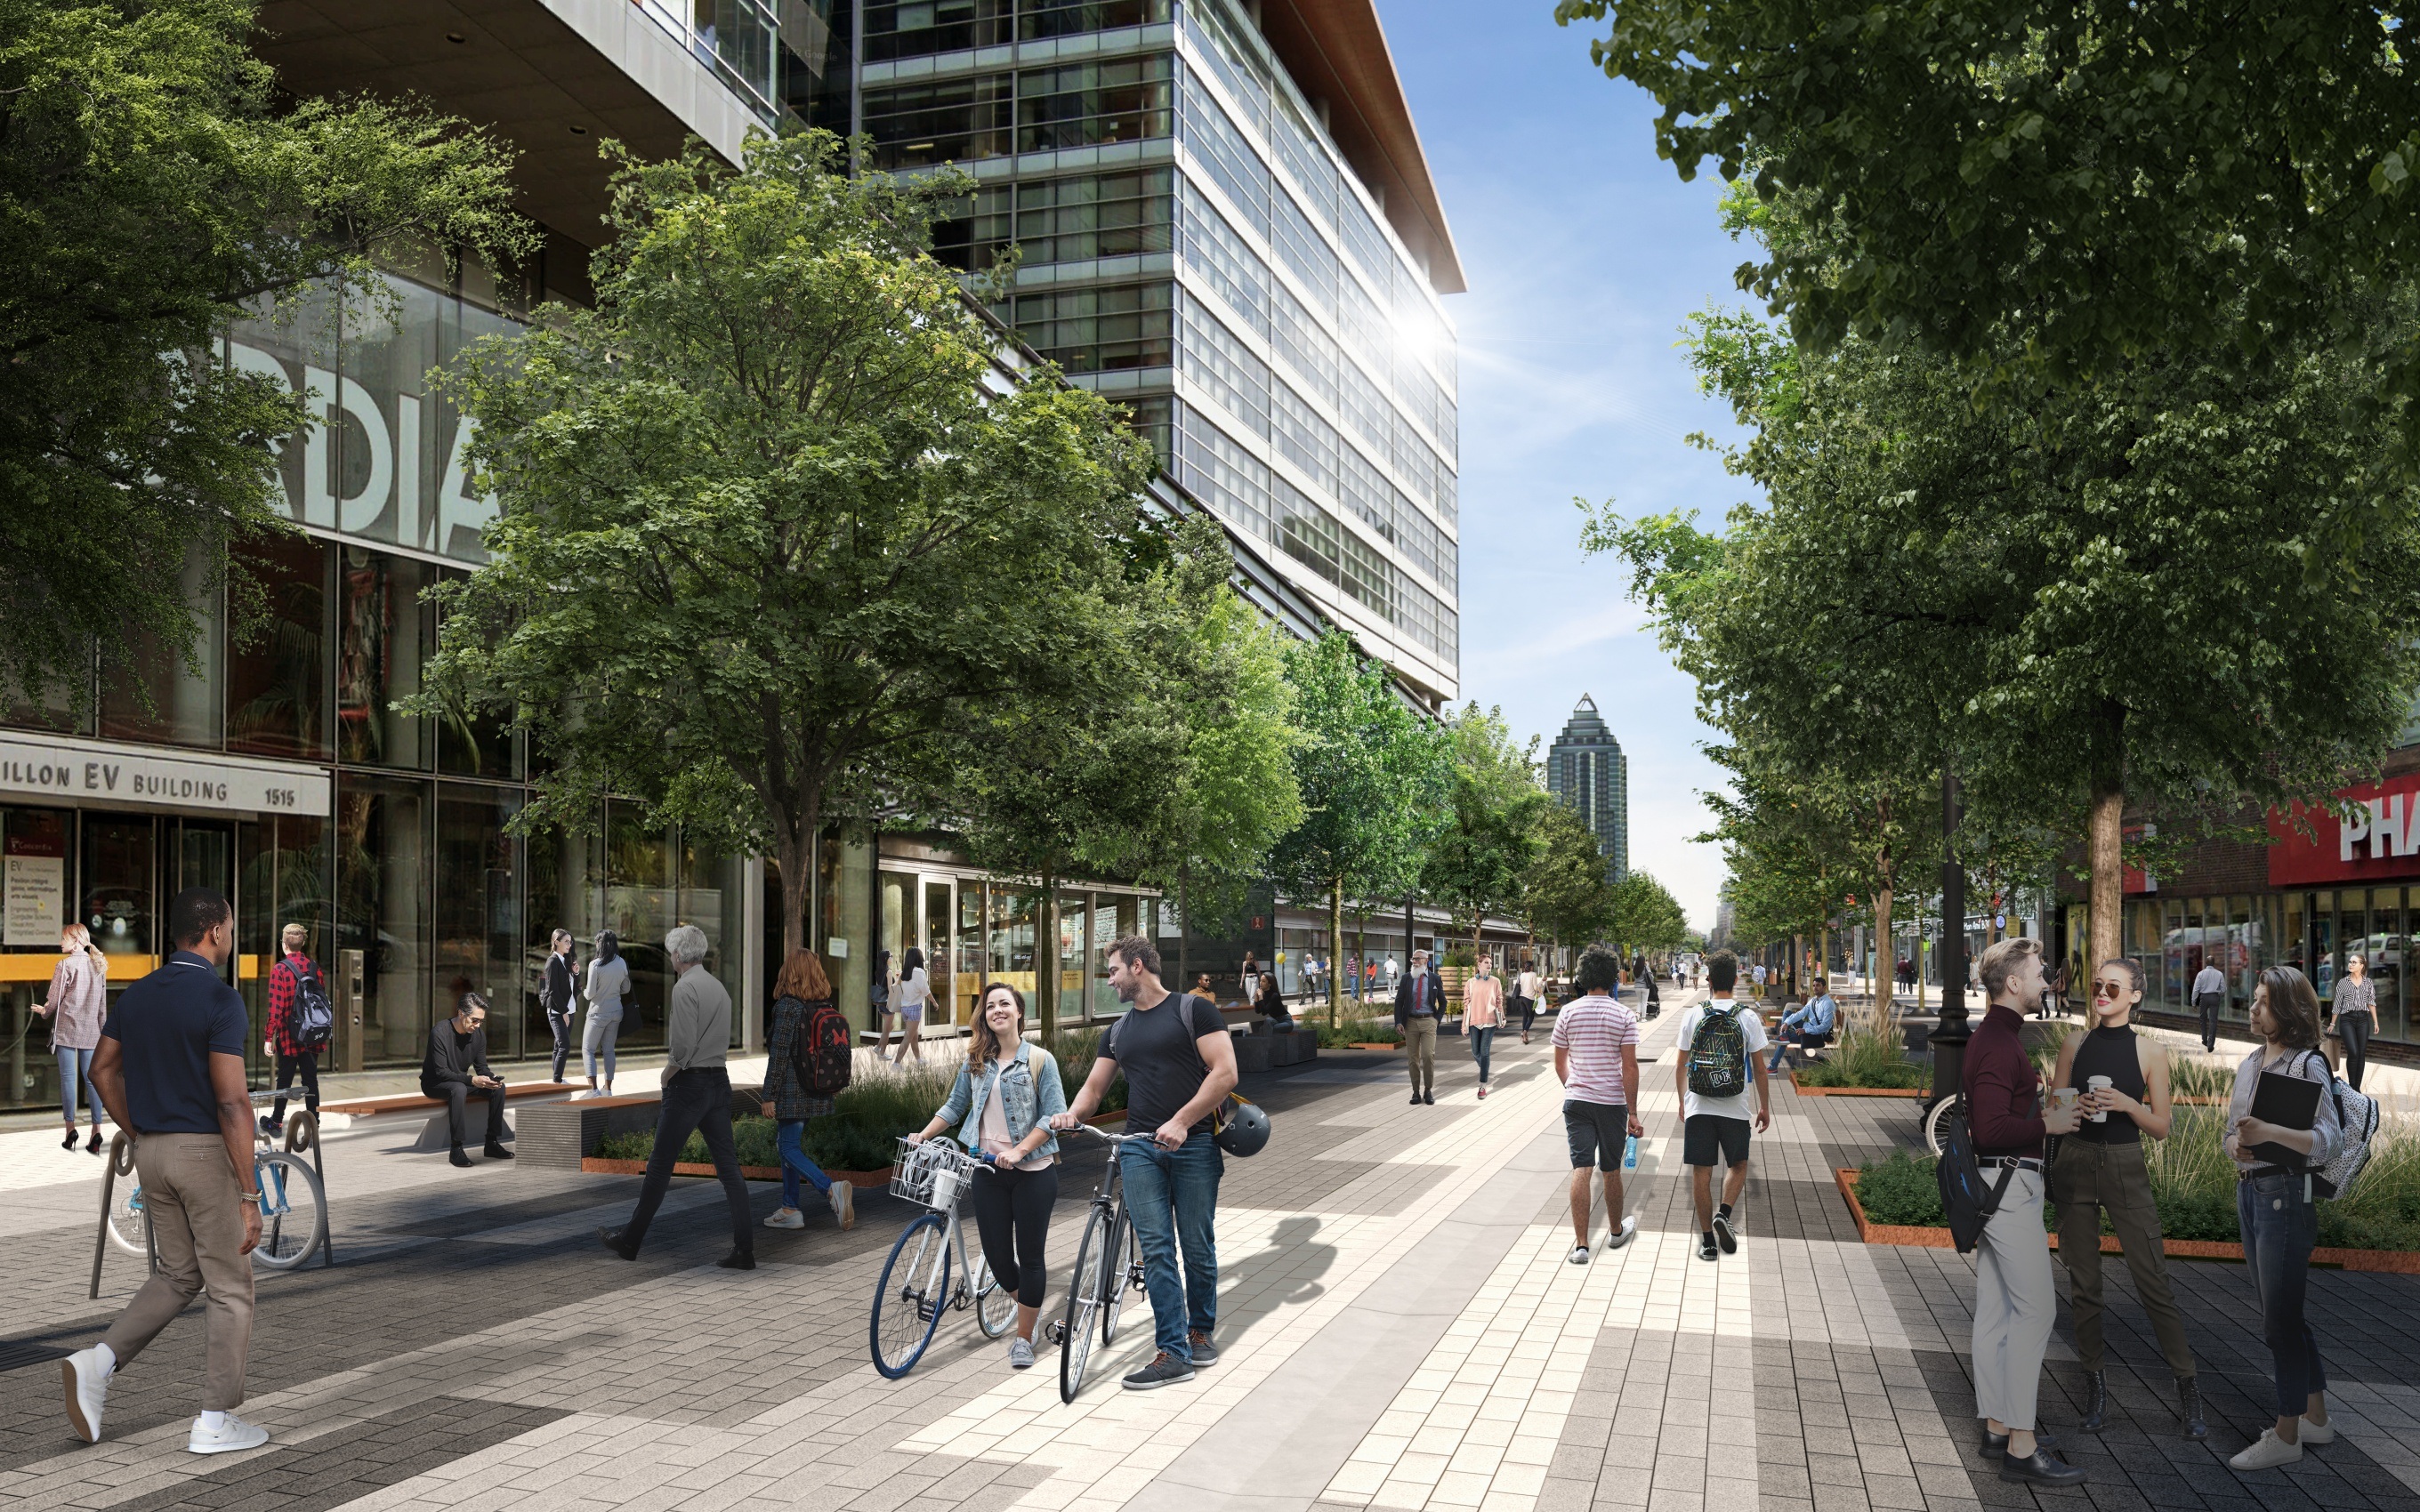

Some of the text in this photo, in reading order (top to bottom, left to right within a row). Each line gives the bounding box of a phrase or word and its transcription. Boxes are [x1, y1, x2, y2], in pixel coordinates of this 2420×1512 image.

[4, 761, 294, 807] ILLON EV BUILDING 1515
[11, 860, 23, 872] EV
